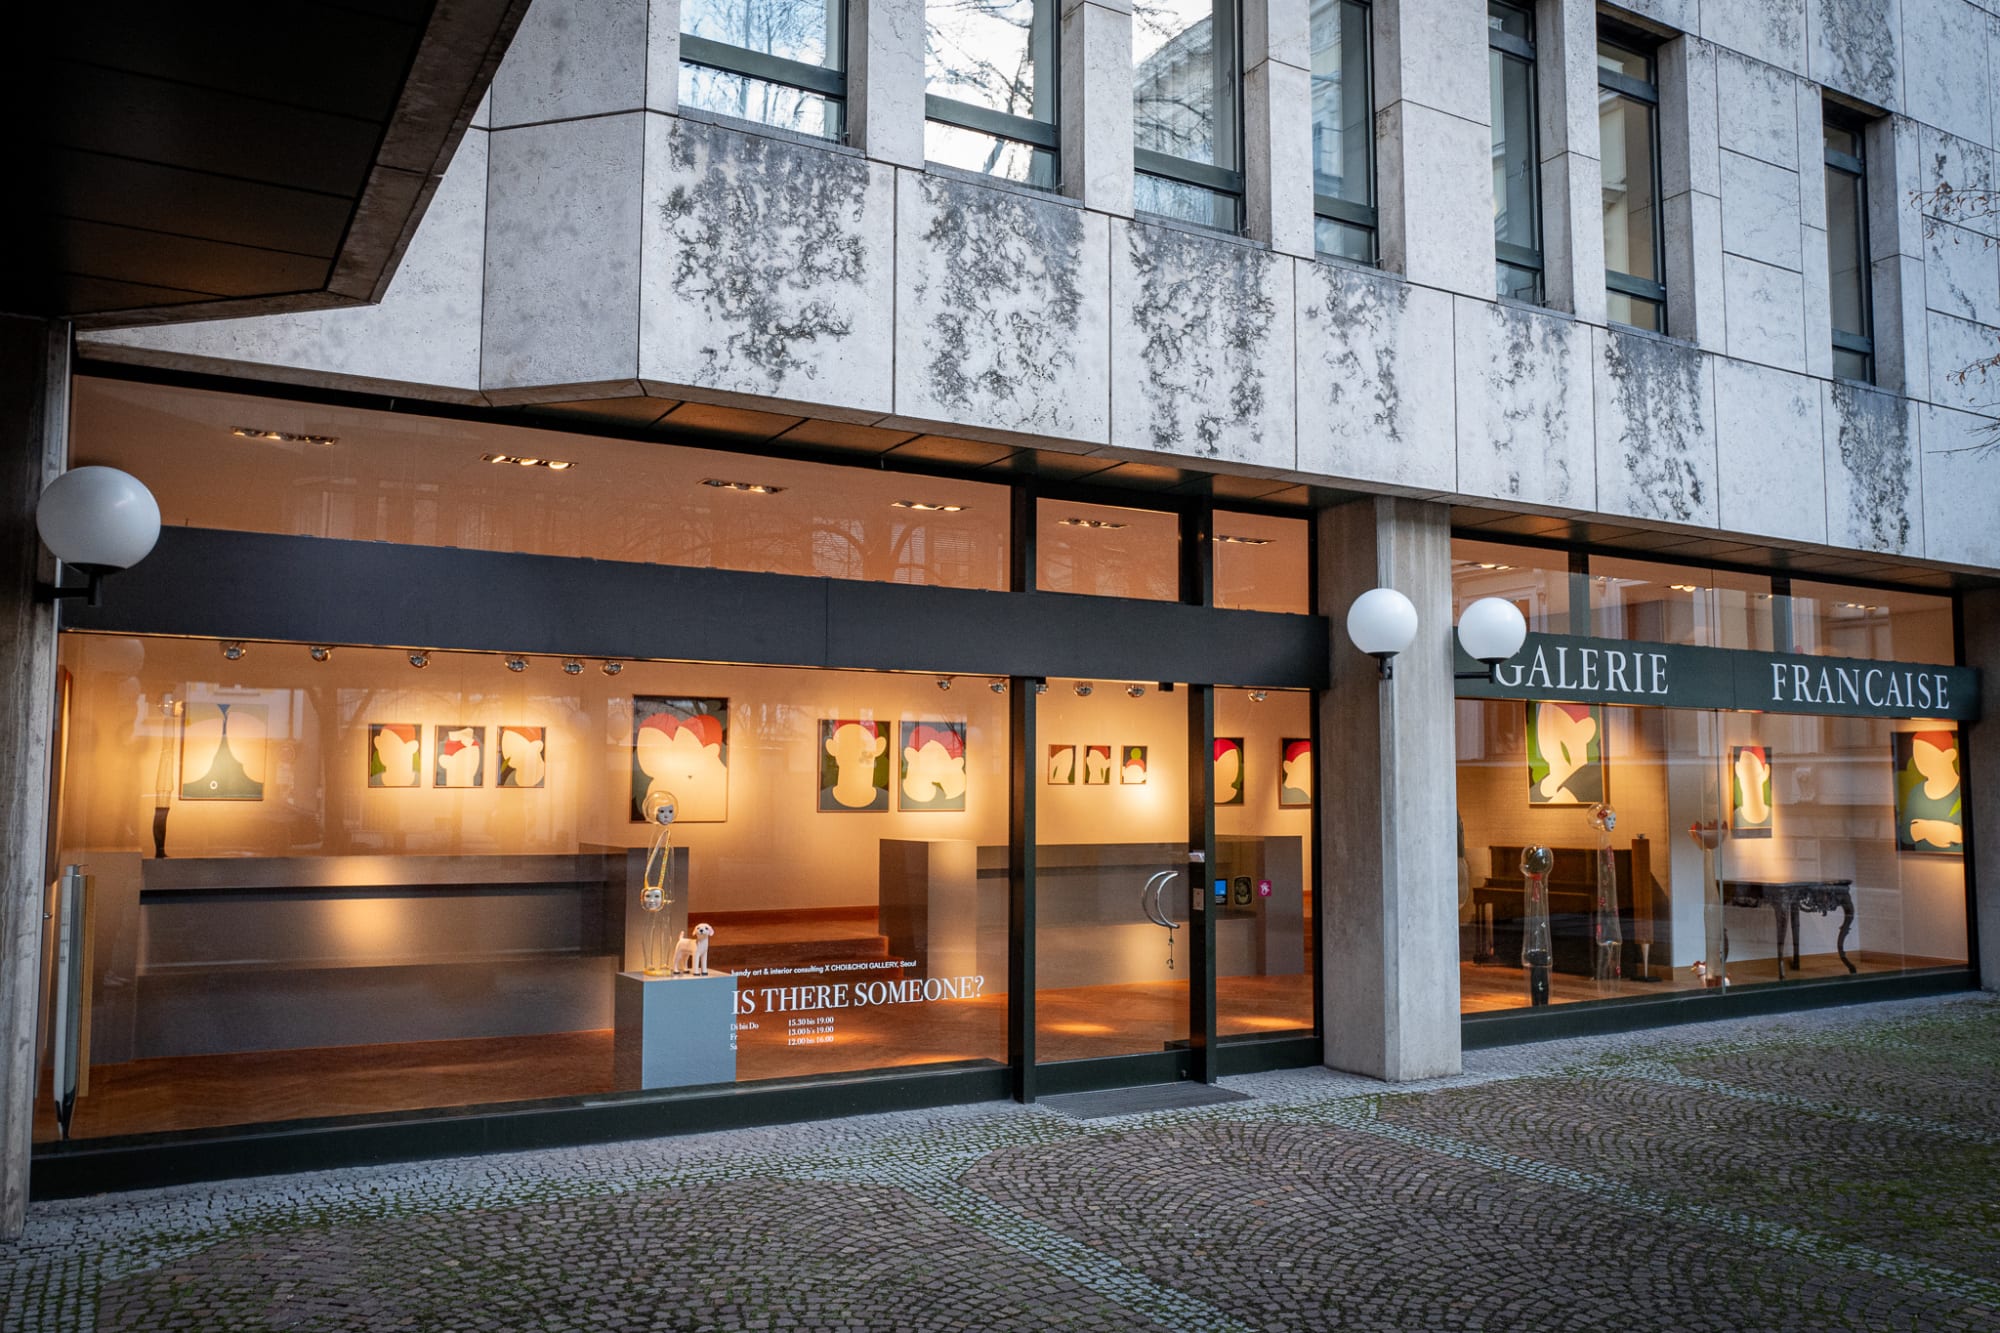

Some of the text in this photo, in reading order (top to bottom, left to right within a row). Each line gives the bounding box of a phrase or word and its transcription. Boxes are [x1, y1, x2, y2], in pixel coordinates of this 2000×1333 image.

[1495, 644, 1669, 694] GALERIE
[1770, 663, 1950, 710] FRANCAISE
[769, 966, 792, 975] interior
[899, 960, 917, 968] Seoul
[731, 975, 985, 1015] IS THERE SOMEONE?
[749, 1022, 759, 1030] Do
[788, 1018, 807, 1027] 15.30
[816, 1016, 834, 1025] 19.00
[788, 1028, 807, 1037] 13.00
[816, 1026, 834, 1034] 19.00
[787, 1037, 807, 1047] 12.00
[816, 1035, 834, 1043] 16.00
